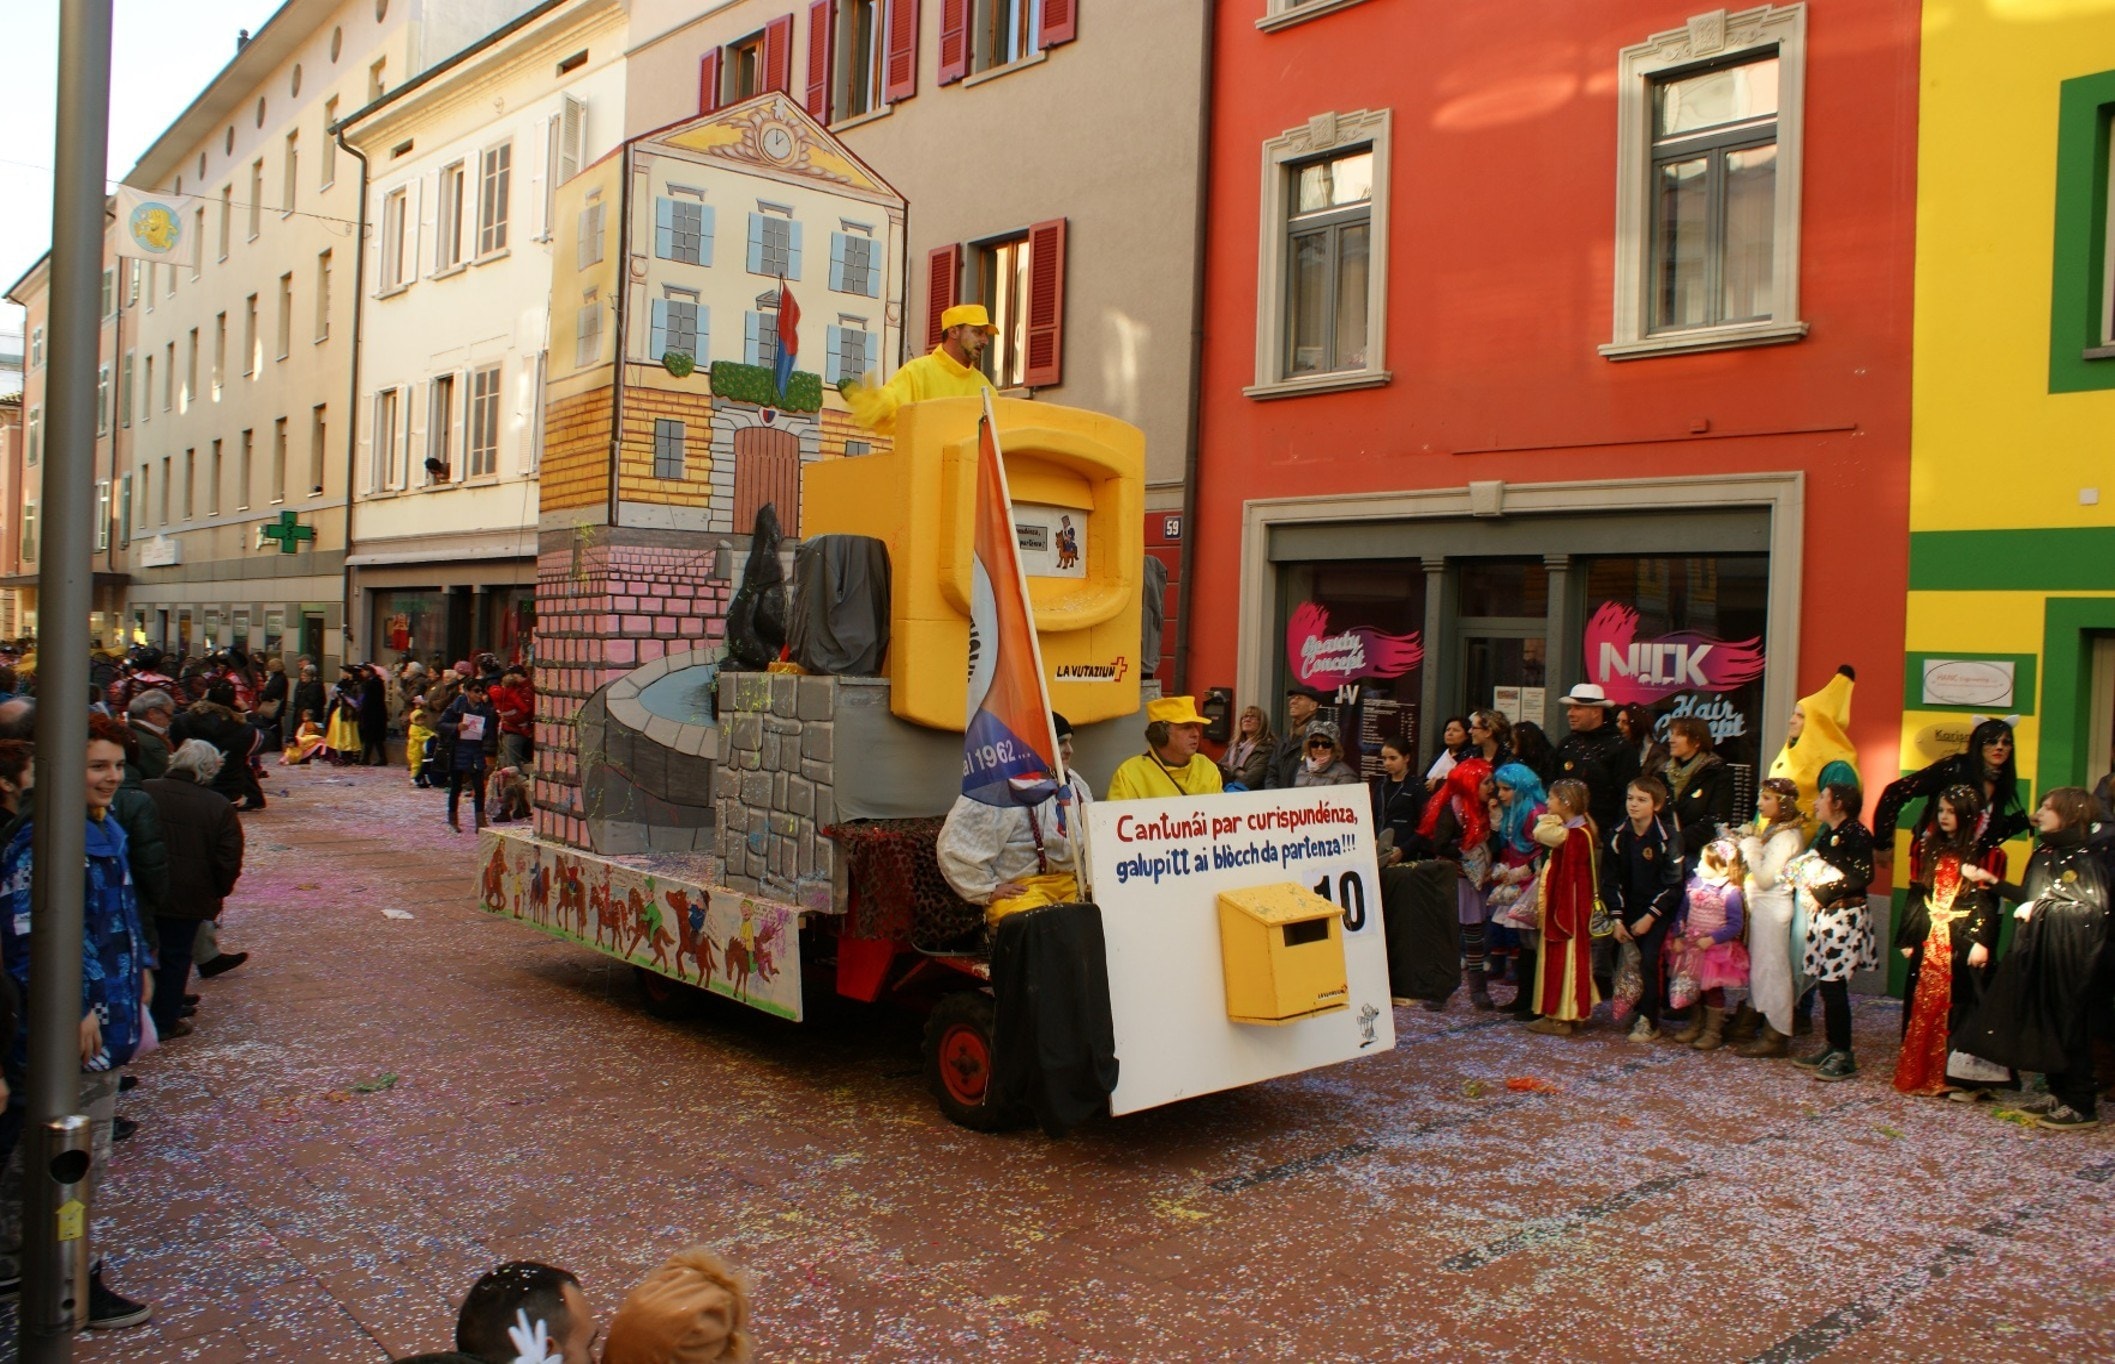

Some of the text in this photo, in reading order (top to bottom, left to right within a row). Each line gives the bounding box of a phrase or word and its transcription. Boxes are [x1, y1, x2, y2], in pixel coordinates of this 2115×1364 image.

[1166, 520, 1179, 535] 59
[1301, 630, 1364, 663] Beauty
[1056, 665, 1116, 677] LA VUTAZIUN
[1301, 650, 1366, 679] Concept
[1600, 642, 1714, 687] NICK
[1670, 694, 1738, 720] Hair
[1117, 800, 1358, 842] Cantunái par curispundénza,
[1194, 847, 1208, 872] ai
[1213, 842, 1259, 870] blòcch
[1260, 840, 1278, 863] da
[1281, 833, 1356, 870] partenza!!!
[1313, 871, 1366, 932] 10
